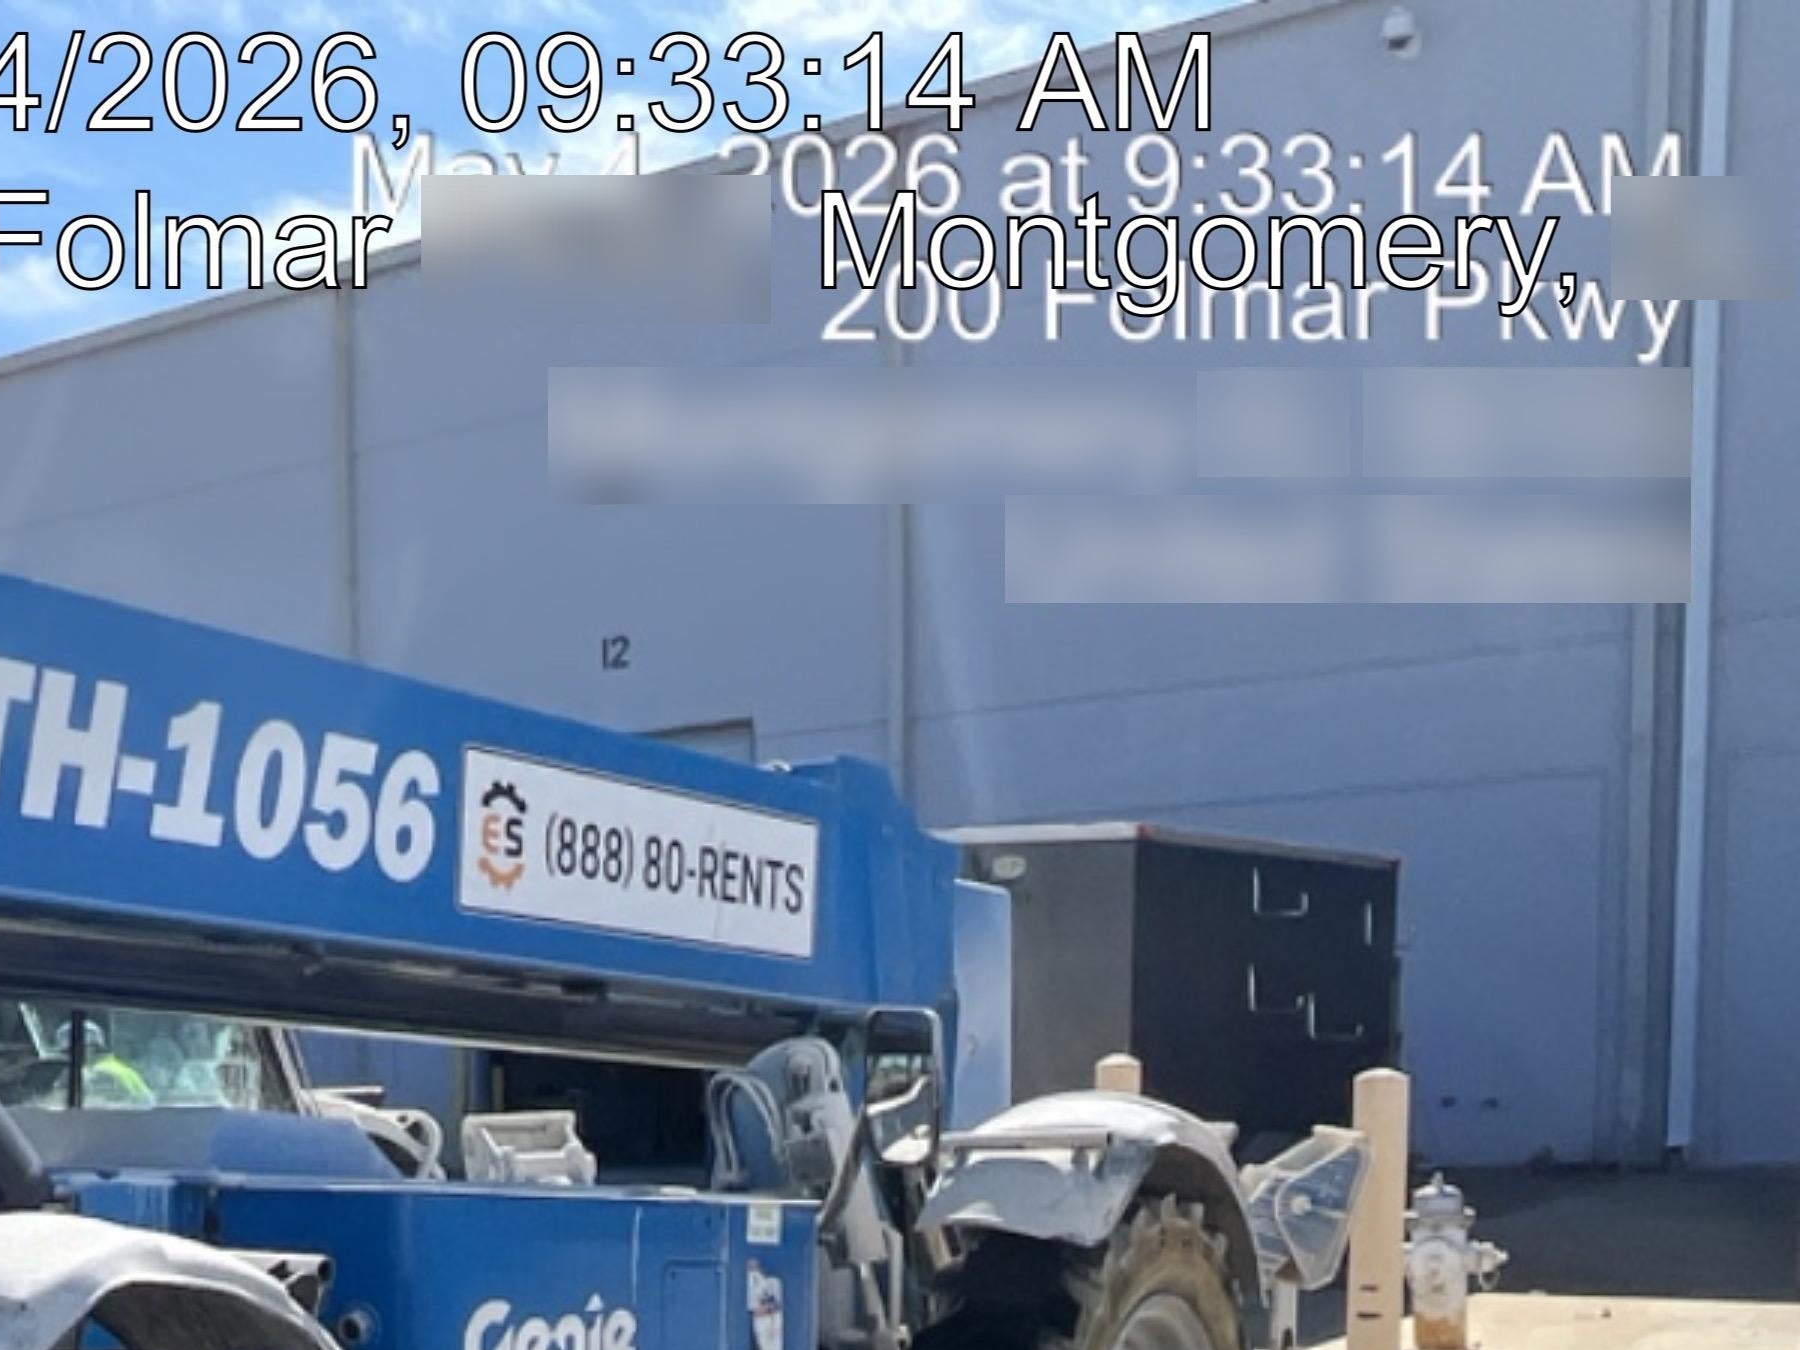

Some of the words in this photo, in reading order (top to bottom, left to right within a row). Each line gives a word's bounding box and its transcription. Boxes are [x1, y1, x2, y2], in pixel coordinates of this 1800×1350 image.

[602, 635, 631, 670] 12
[545, 811, 635, 889] (888)
[642, 835, 805, 914] 80-RENTS
